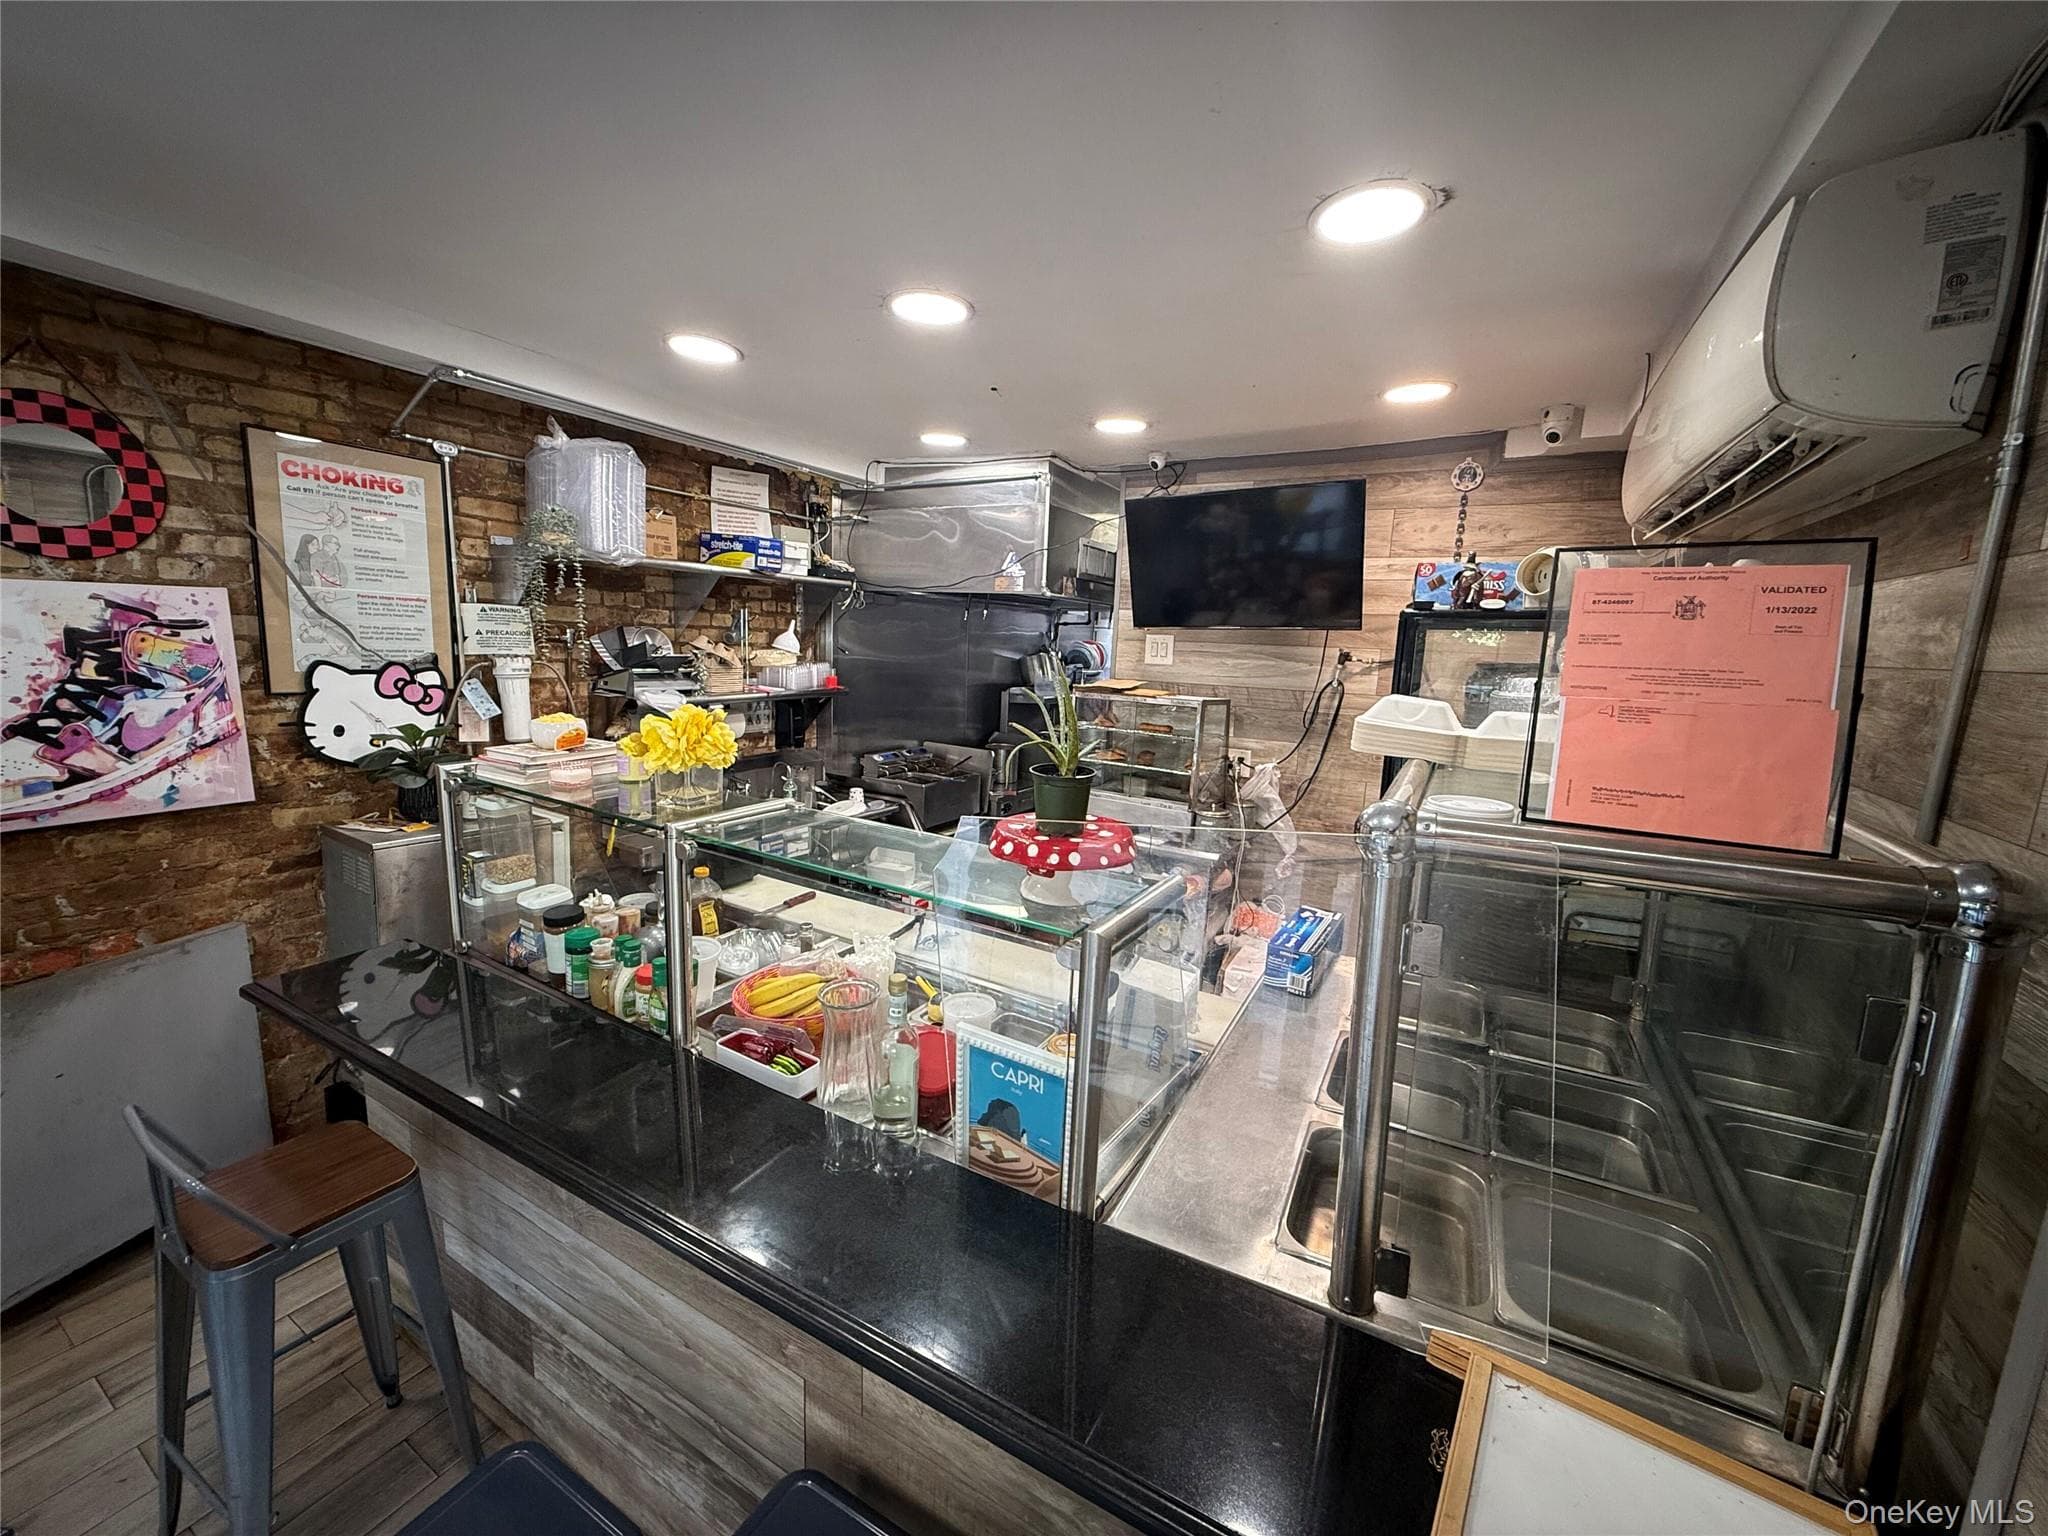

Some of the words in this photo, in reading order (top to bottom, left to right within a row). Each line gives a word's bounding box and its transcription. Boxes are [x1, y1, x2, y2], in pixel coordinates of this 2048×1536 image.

[280, 459, 404, 494] CHOKING
[322, 491, 346, 499] person
[394, 501, 419, 510] breathe
[1420, 565, 1433, 574] 50
[1761, 586, 1828, 594] VALIDATED
[488, 606, 522, 614] WARNING
[1765, 606, 1818, 614] 1/13/2022
[990, 1061, 1044, 1094] CAPRI
